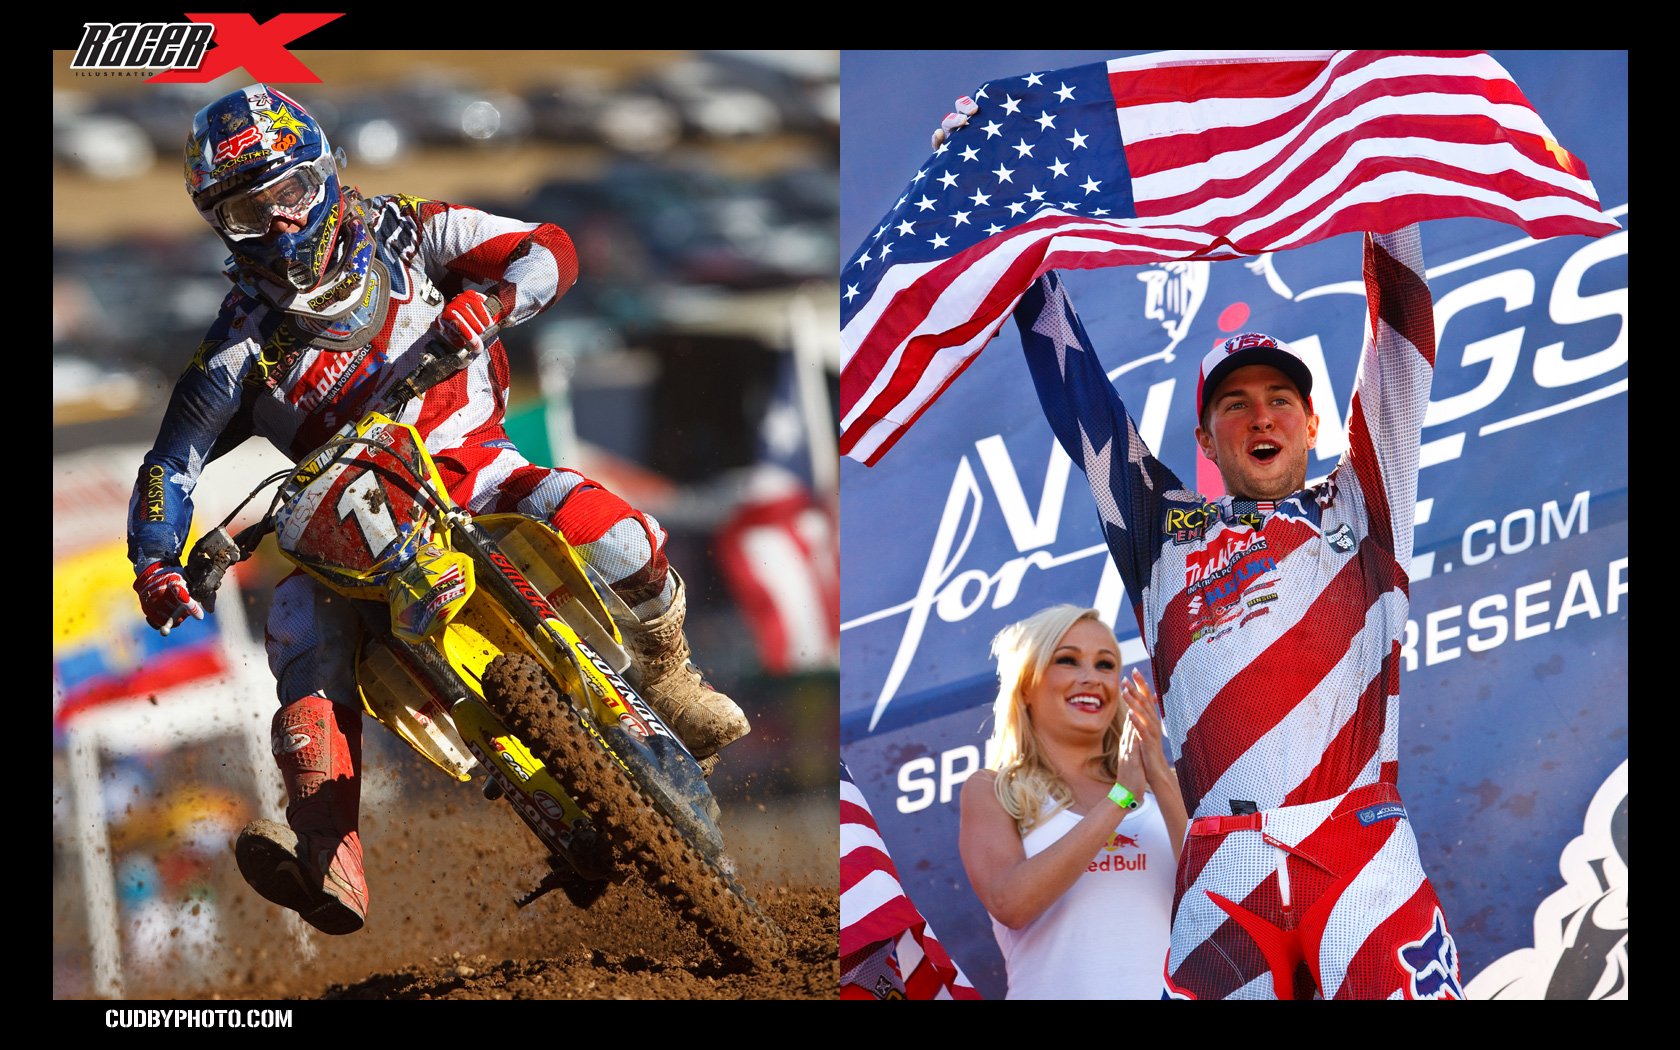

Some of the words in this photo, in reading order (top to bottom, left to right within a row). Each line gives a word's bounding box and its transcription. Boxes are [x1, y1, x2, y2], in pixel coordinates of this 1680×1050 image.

[340, 362, 358, 387] POWER
[355, 343, 373, 366] TOOLS
[1228, 338, 1275, 354] USA
[286, 489, 322, 541] USA
[336, 469, 399, 559] 1
[491, 553, 557, 620] HOWA
[840, 455, 1110, 733] for
[576, 642, 672, 739] DUNLOP
[1085, 855, 1110, 872] ed
[1114, 854, 1146, 871] Bull
